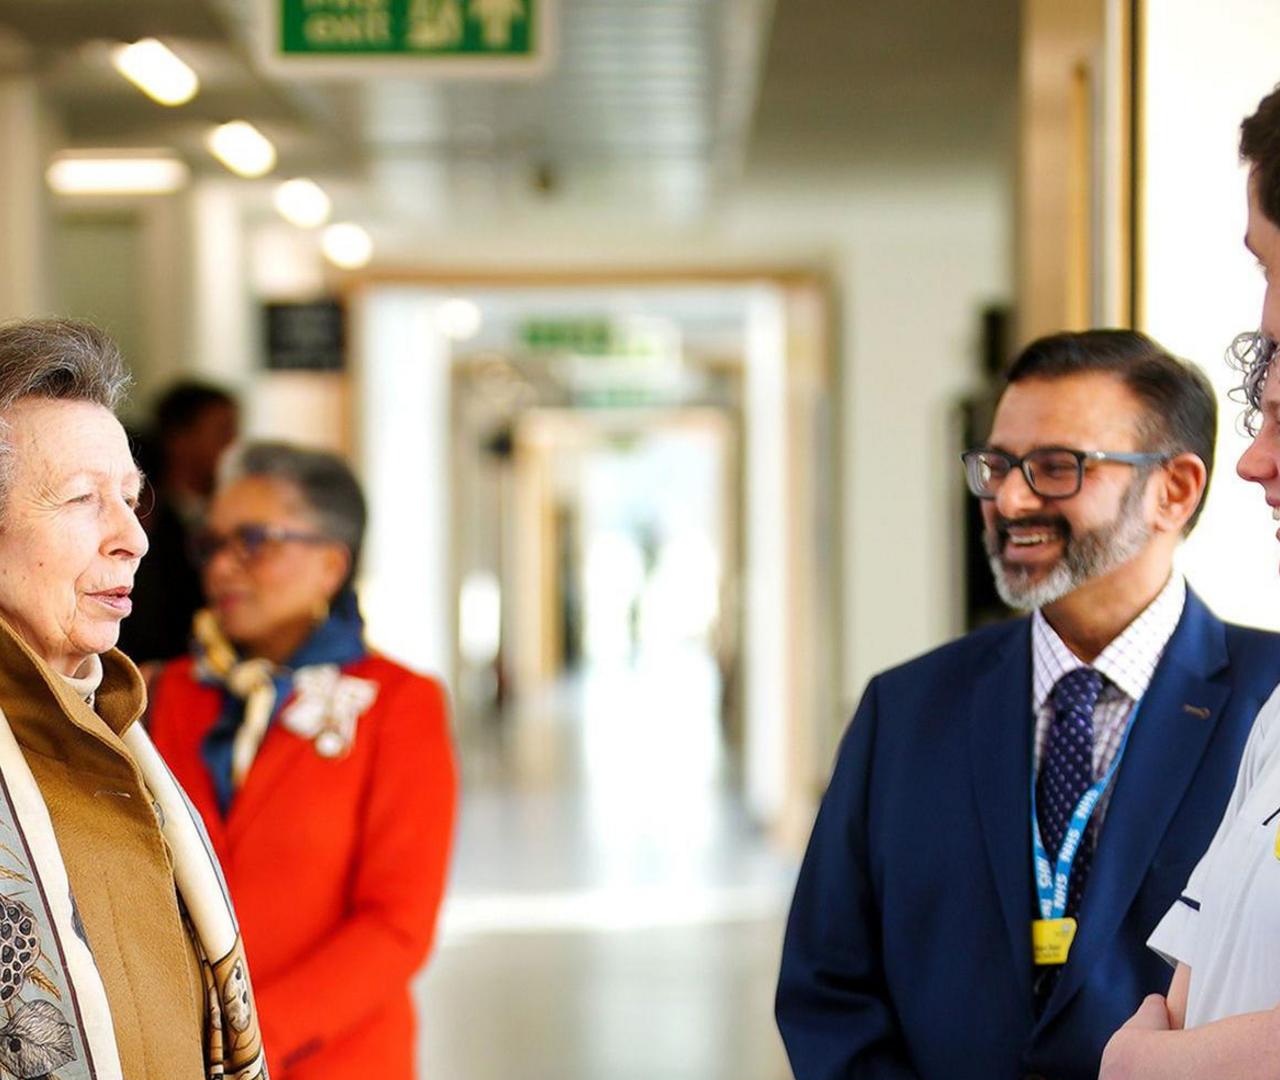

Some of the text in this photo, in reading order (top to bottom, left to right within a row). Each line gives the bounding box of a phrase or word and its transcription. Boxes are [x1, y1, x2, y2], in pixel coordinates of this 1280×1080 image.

[1075, 788, 1099, 819] NHS
[1058, 827, 1080, 862] NHS
[1053, 873, 1068, 909] NHS
